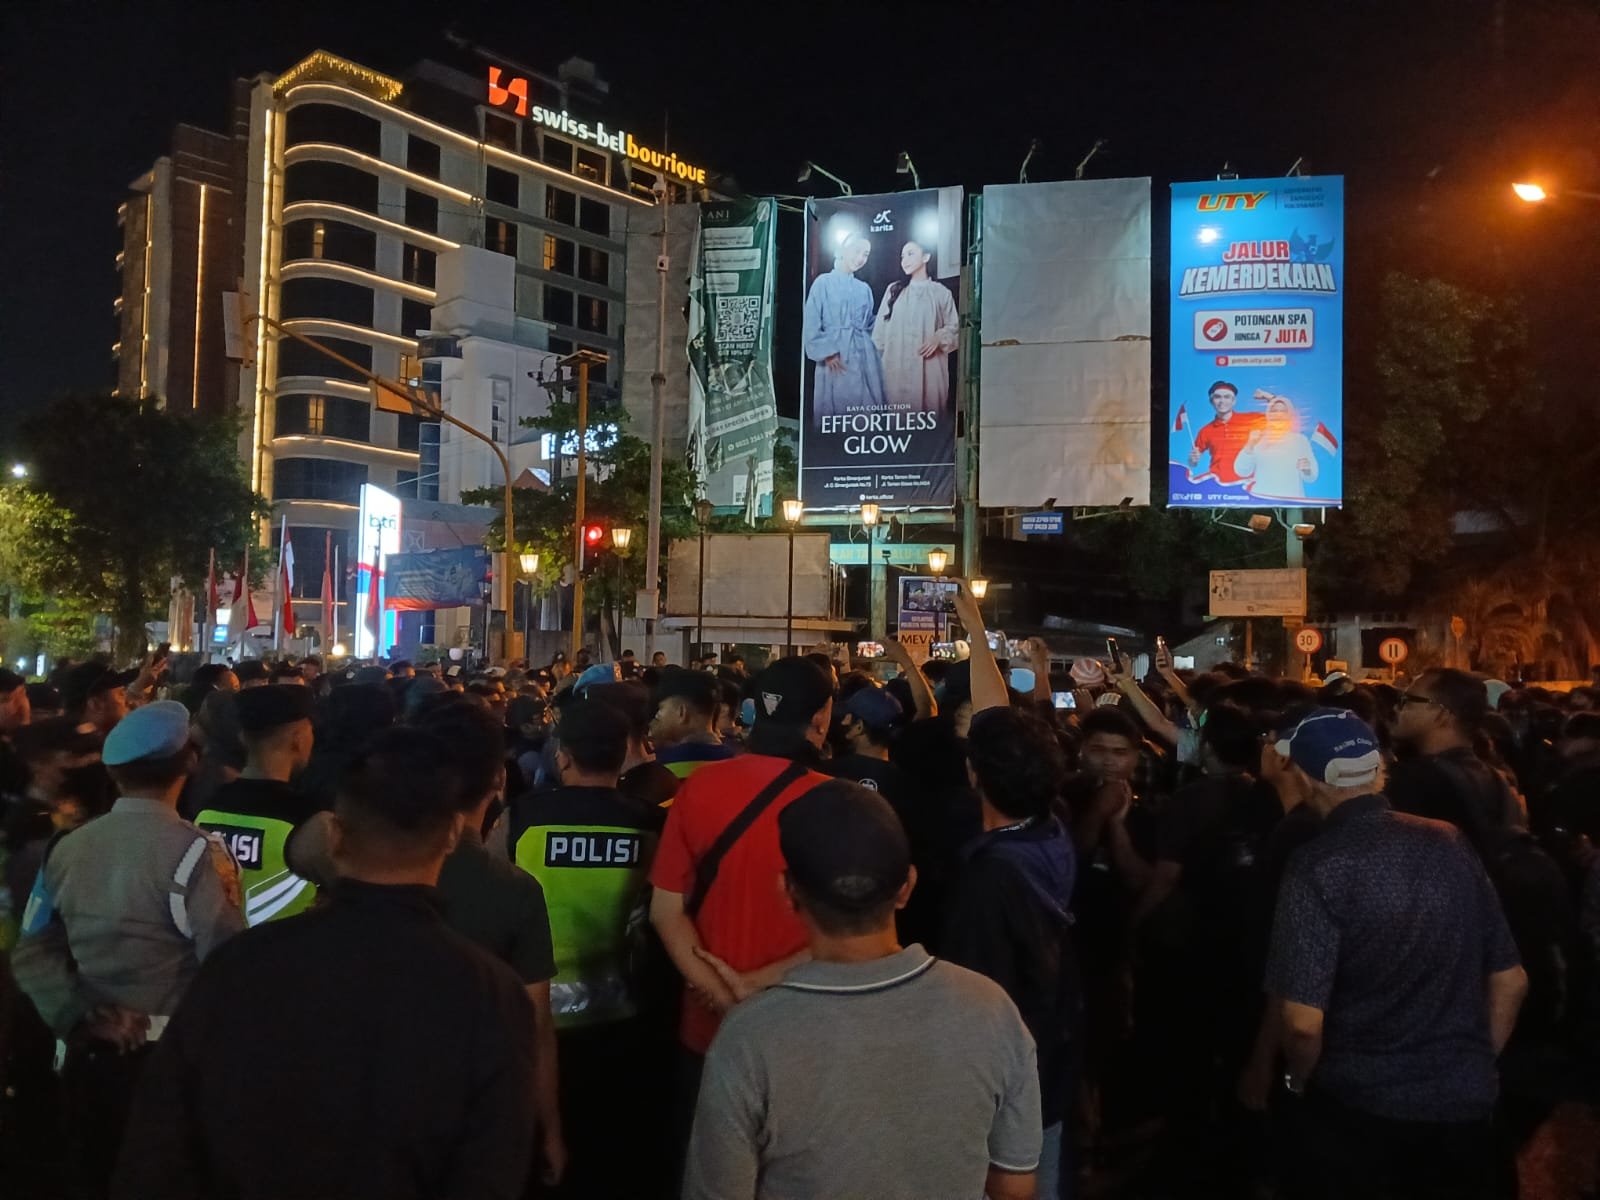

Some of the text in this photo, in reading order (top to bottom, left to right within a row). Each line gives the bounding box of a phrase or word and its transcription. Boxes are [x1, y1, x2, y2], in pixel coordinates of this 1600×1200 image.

[1196, 192, 1269, 212] UTY
[1224, 240, 1290, 262] JALUR
[1180, 263, 1337, 295] KEMERDEKAAN
[1234, 313, 1307, 326] POTONGAN SPA
[1234, 329, 1307, 344] HINGGA 7 JUTA
[846, 403, 912, 412] RAYA COLLECTION
[821, 411, 937, 434] EFFORTLESS
[844, 434, 912, 455] GLOW
[1300, 635, 1312, 646] 30
[551, 837, 639, 863] POLISI
